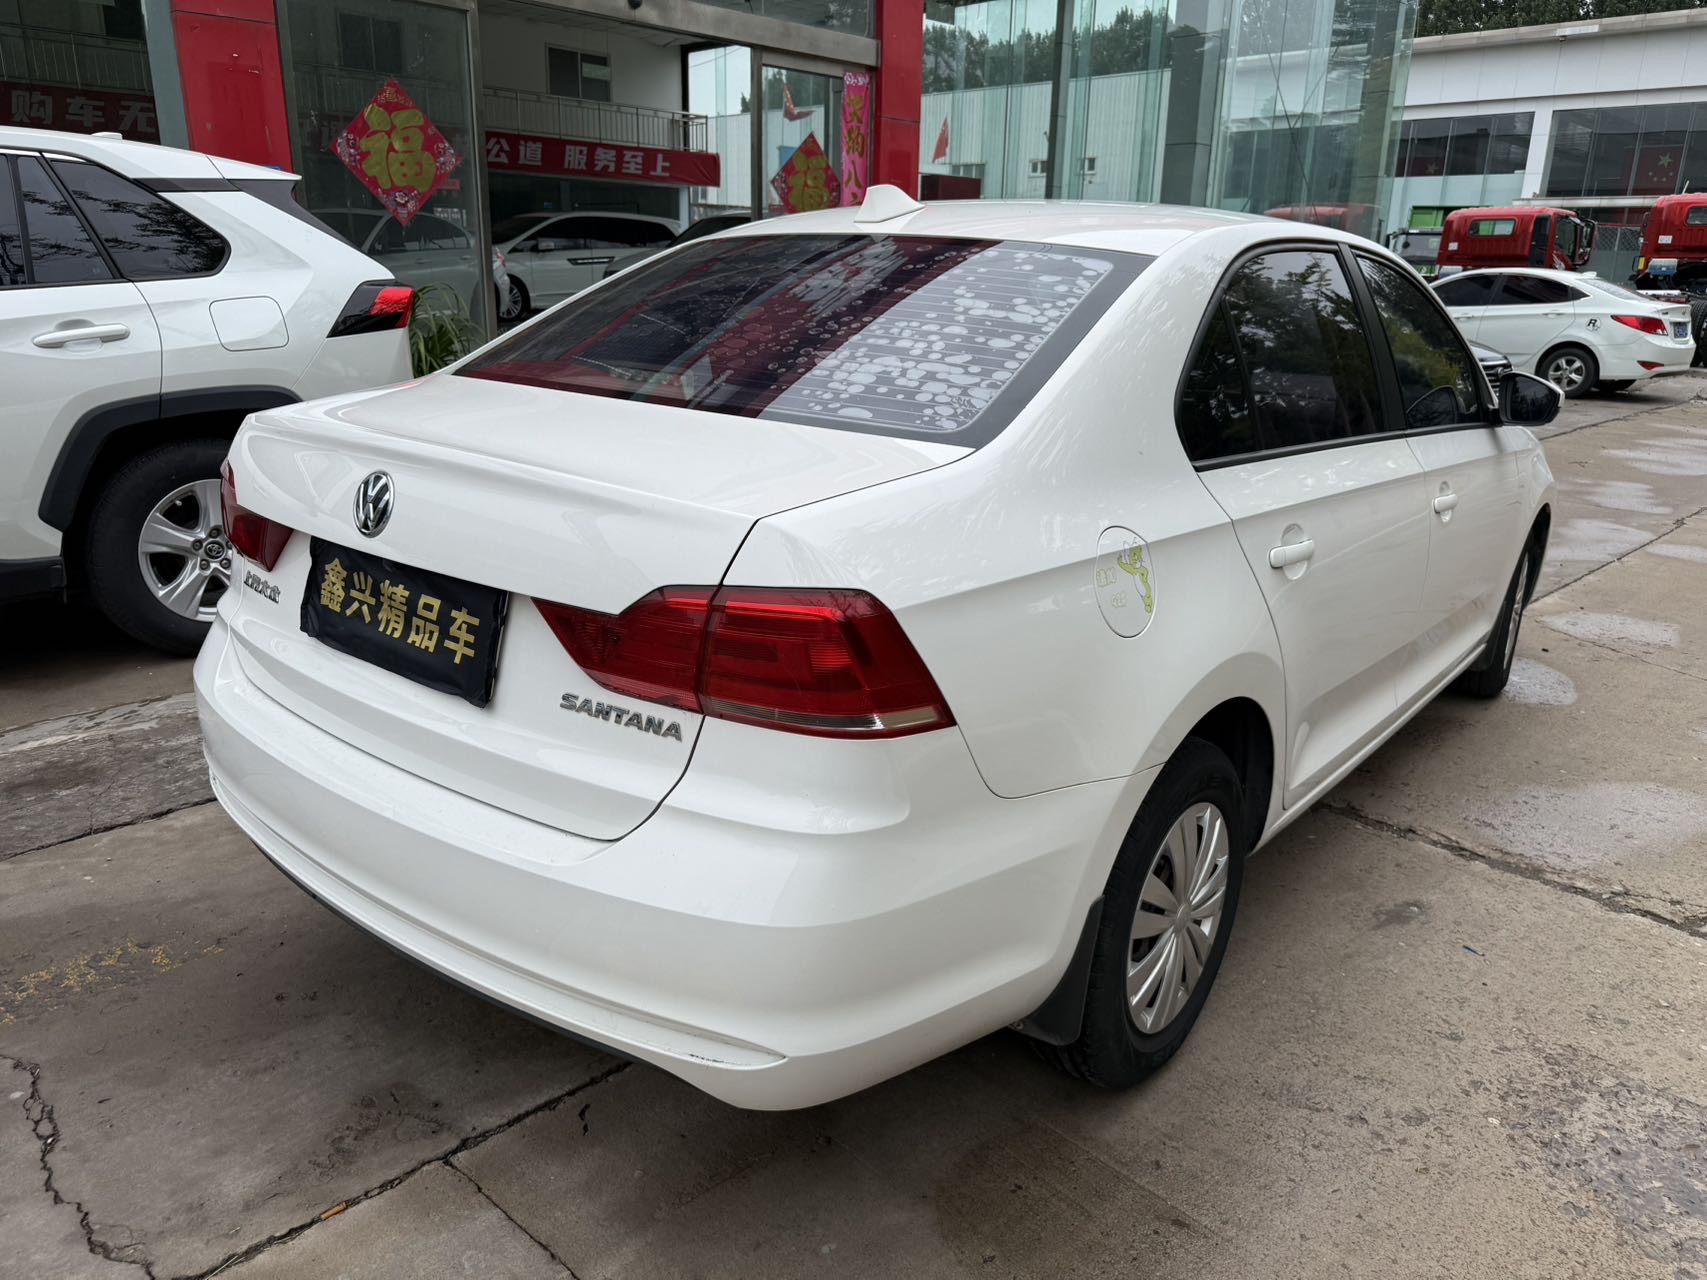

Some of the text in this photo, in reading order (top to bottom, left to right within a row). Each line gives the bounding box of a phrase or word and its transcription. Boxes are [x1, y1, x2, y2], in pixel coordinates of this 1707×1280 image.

[11, 90, 155, 133] 购车无
[359, 104, 436, 192] 福
[485, 137, 671, 177] 公道 服务至上
[320, 557, 480, 665] 鑫兴精品车
[560, 693, 682, 742] SANTANA
